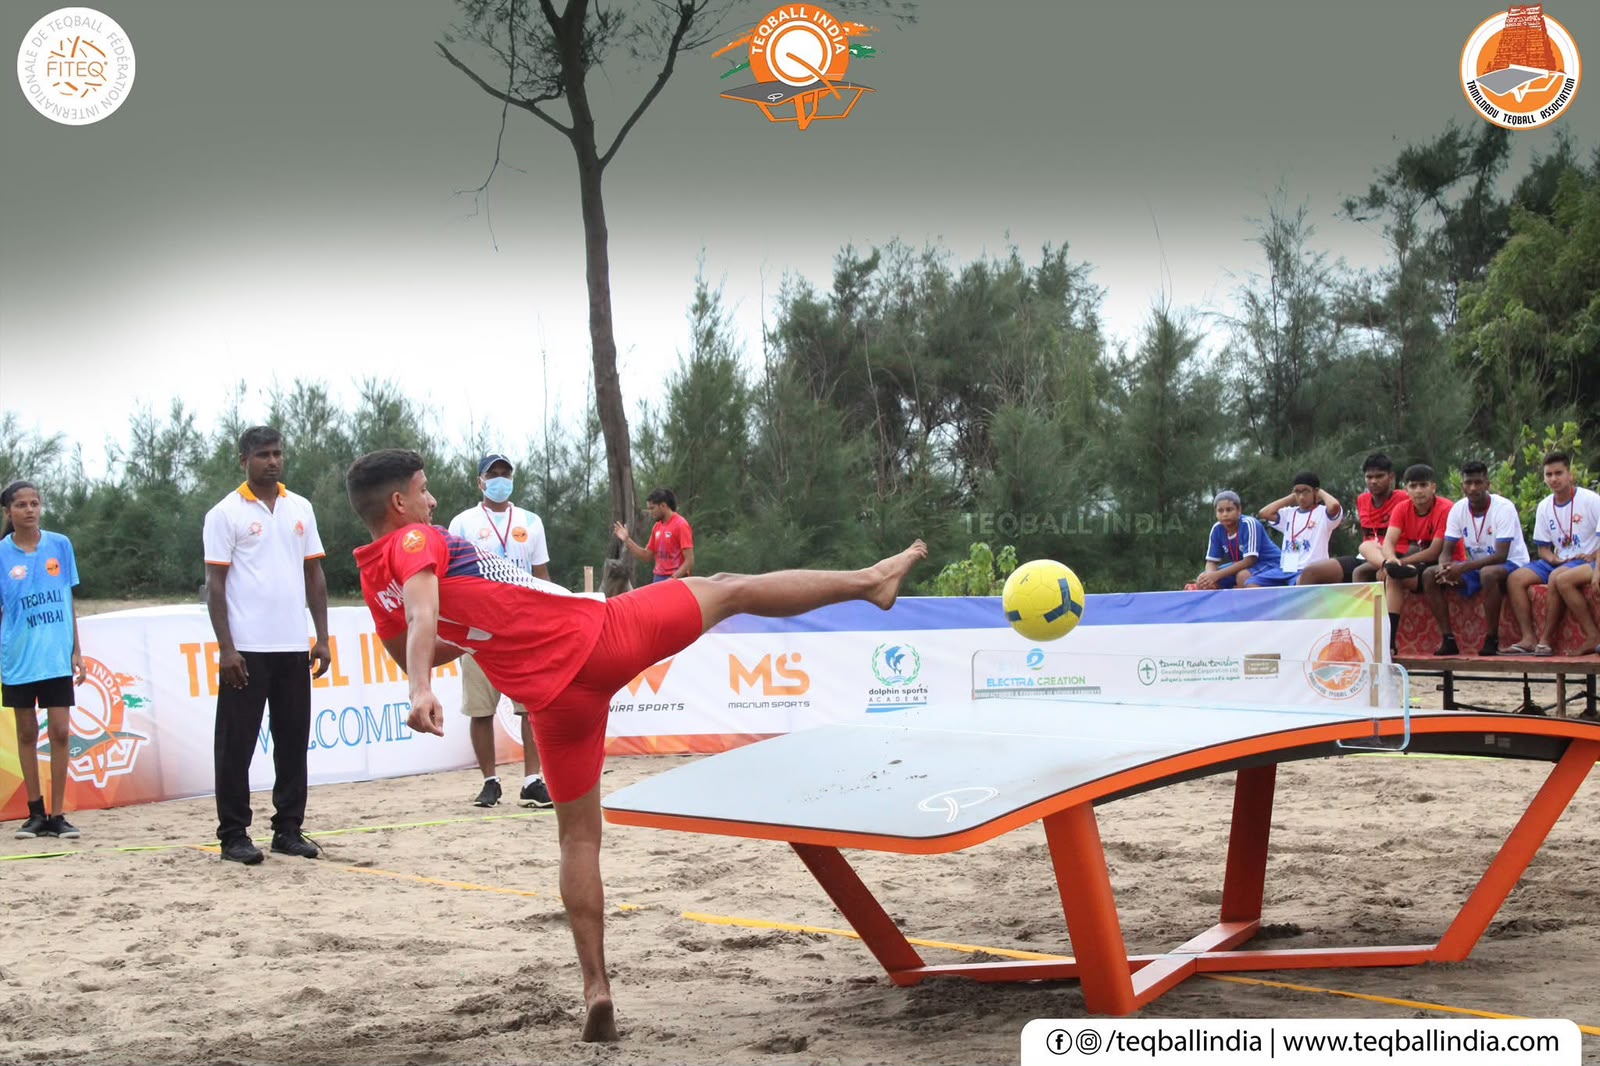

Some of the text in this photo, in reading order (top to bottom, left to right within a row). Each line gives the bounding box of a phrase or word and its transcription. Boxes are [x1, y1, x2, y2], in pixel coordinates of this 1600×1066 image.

[20, 588, 64, 610] TEQBALL
[27, 609, 64, 628] MUMBAI
[92, 663, 122, 706] INDIA
[1036, 675, 1087, 686] CREATION
[868, 687, 928, 696] dolphin sports
[638, 703, 685, 712] SPORTS
[728, 701, 769, 709] MAGNUM
